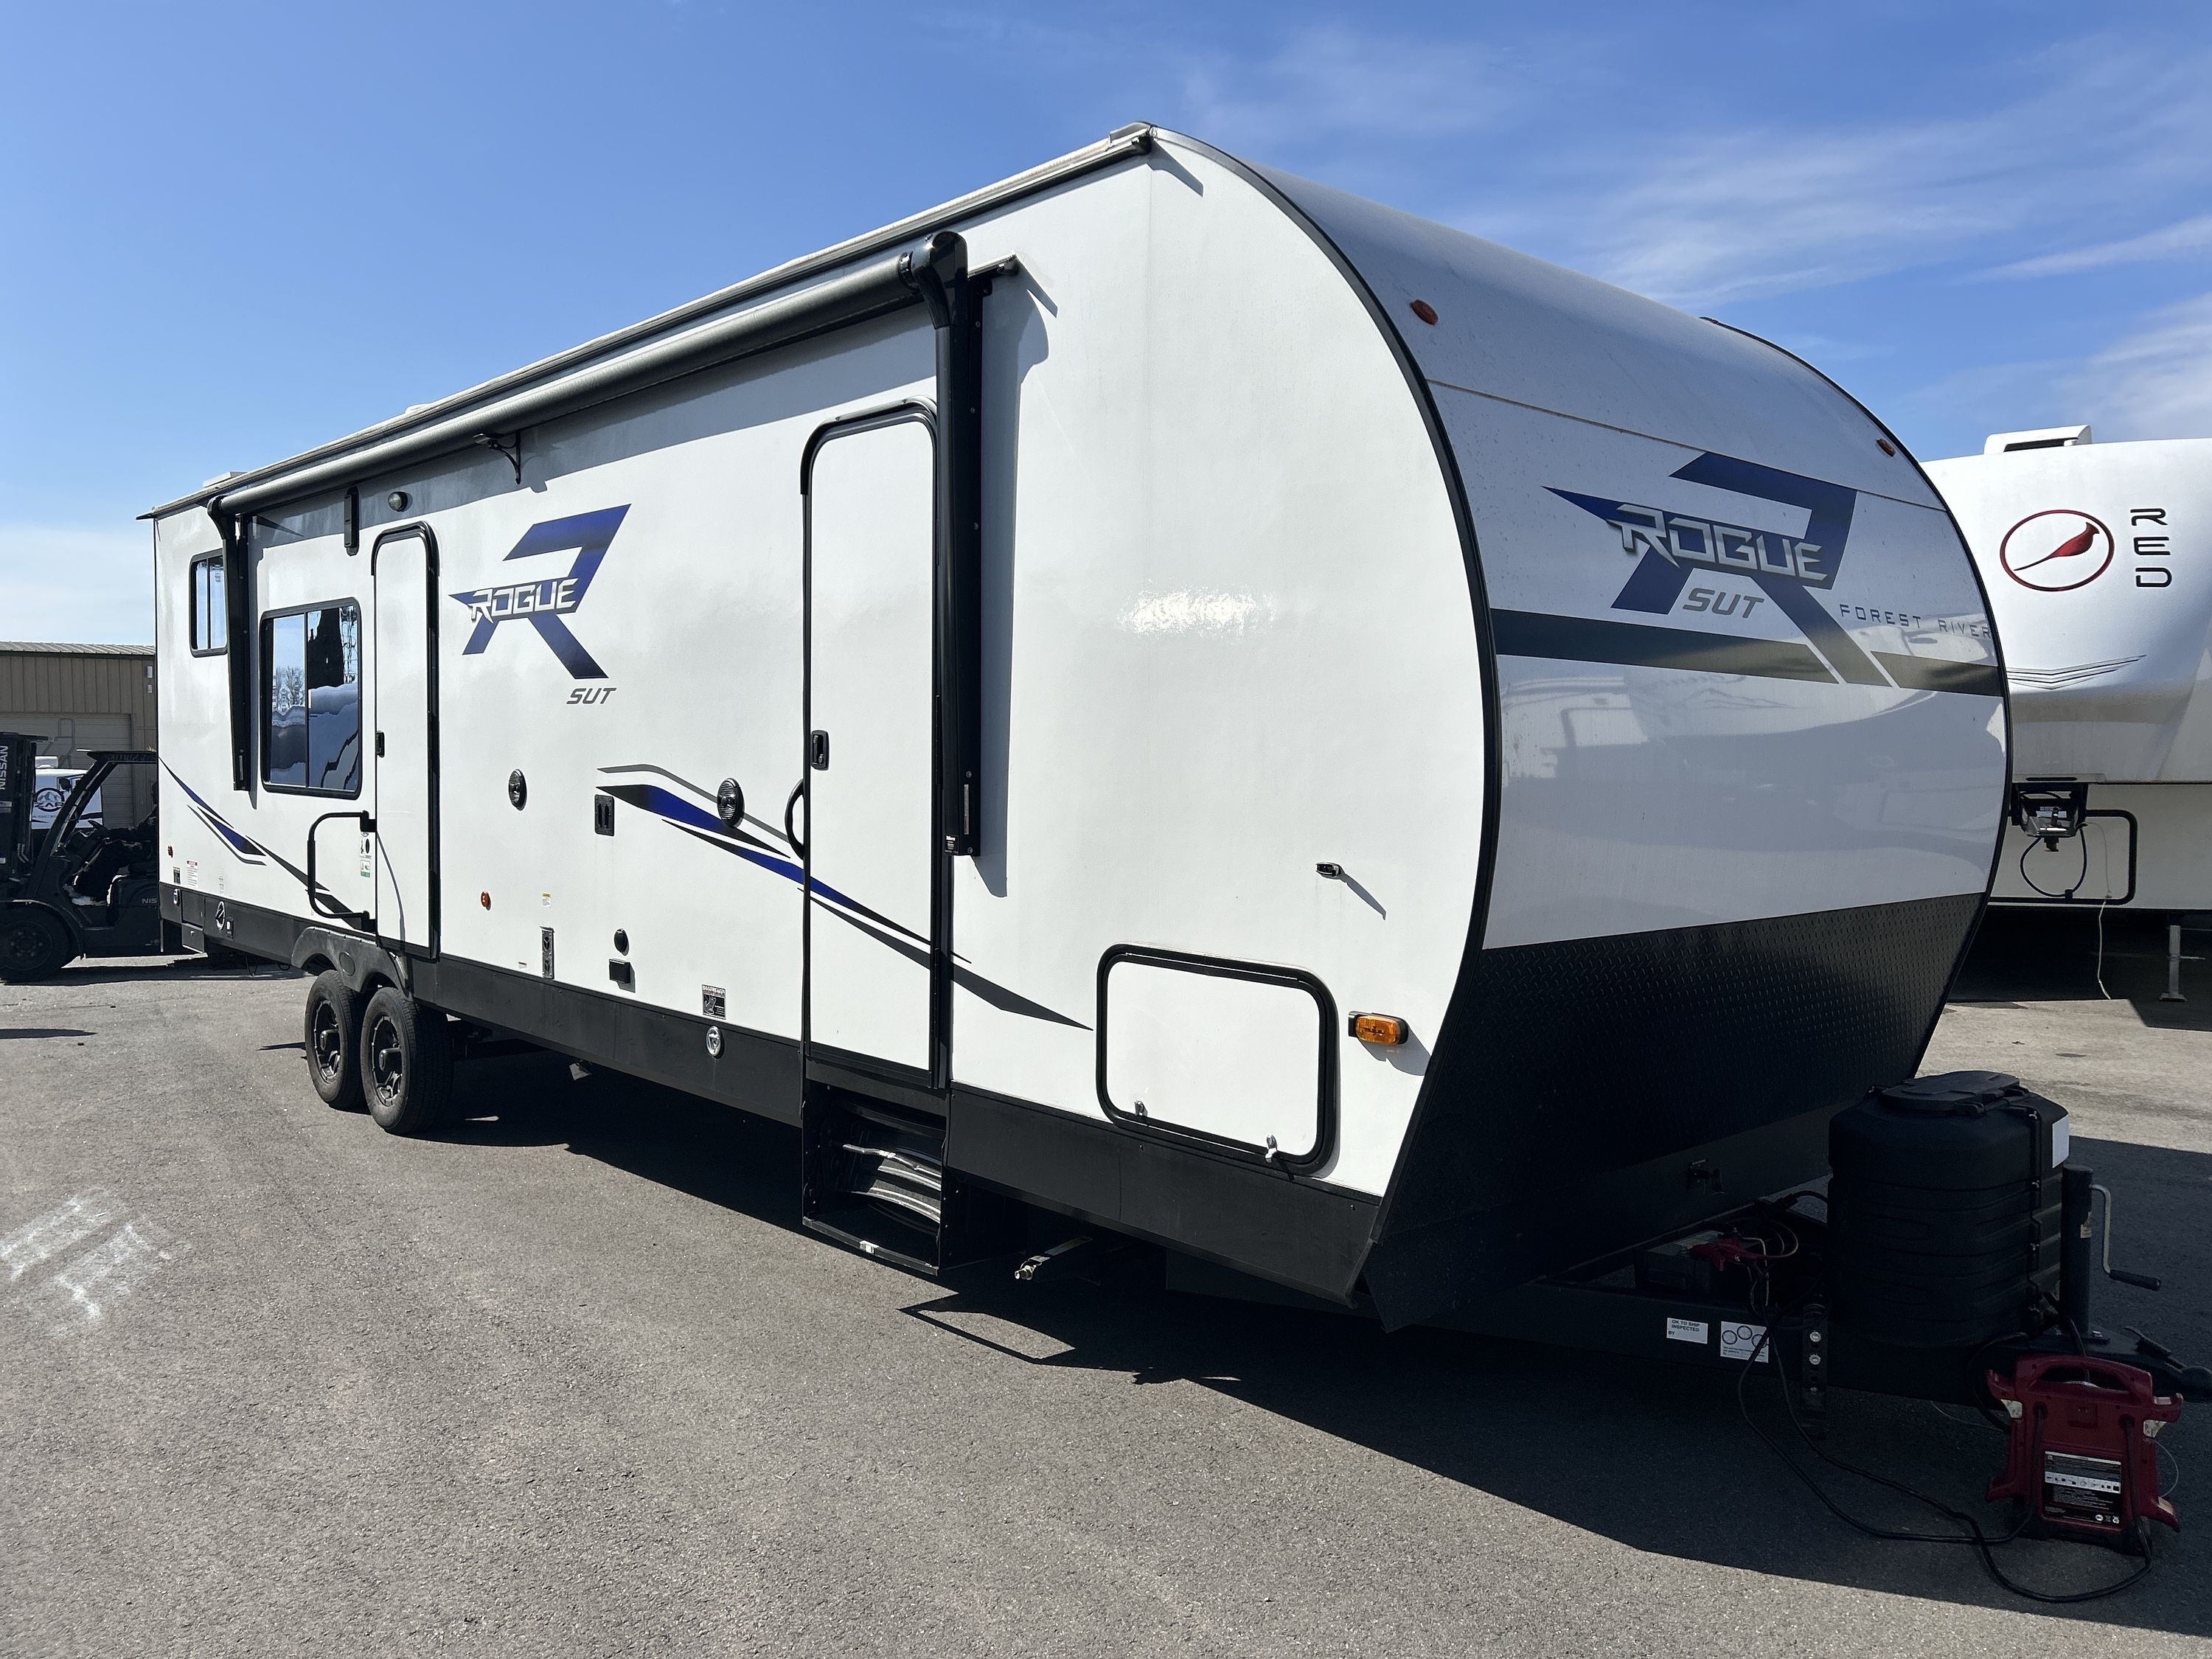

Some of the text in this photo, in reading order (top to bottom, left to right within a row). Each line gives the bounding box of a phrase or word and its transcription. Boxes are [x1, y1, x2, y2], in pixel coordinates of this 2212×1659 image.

[1606, 504, 1828, 581] ROGUE
[2130, 508, 2172, 588] RED
[467, 578, 579, 624] ROGUE
[1683, 588, 1764, 619] SUT
[1840, 604, 1991, 639] FOREST RIVER
[566, 688, 616, 704] SUT
[0, 745, 8, 790] NISSAN
[1672, 1324, 1700, 1332] INSPECTED
